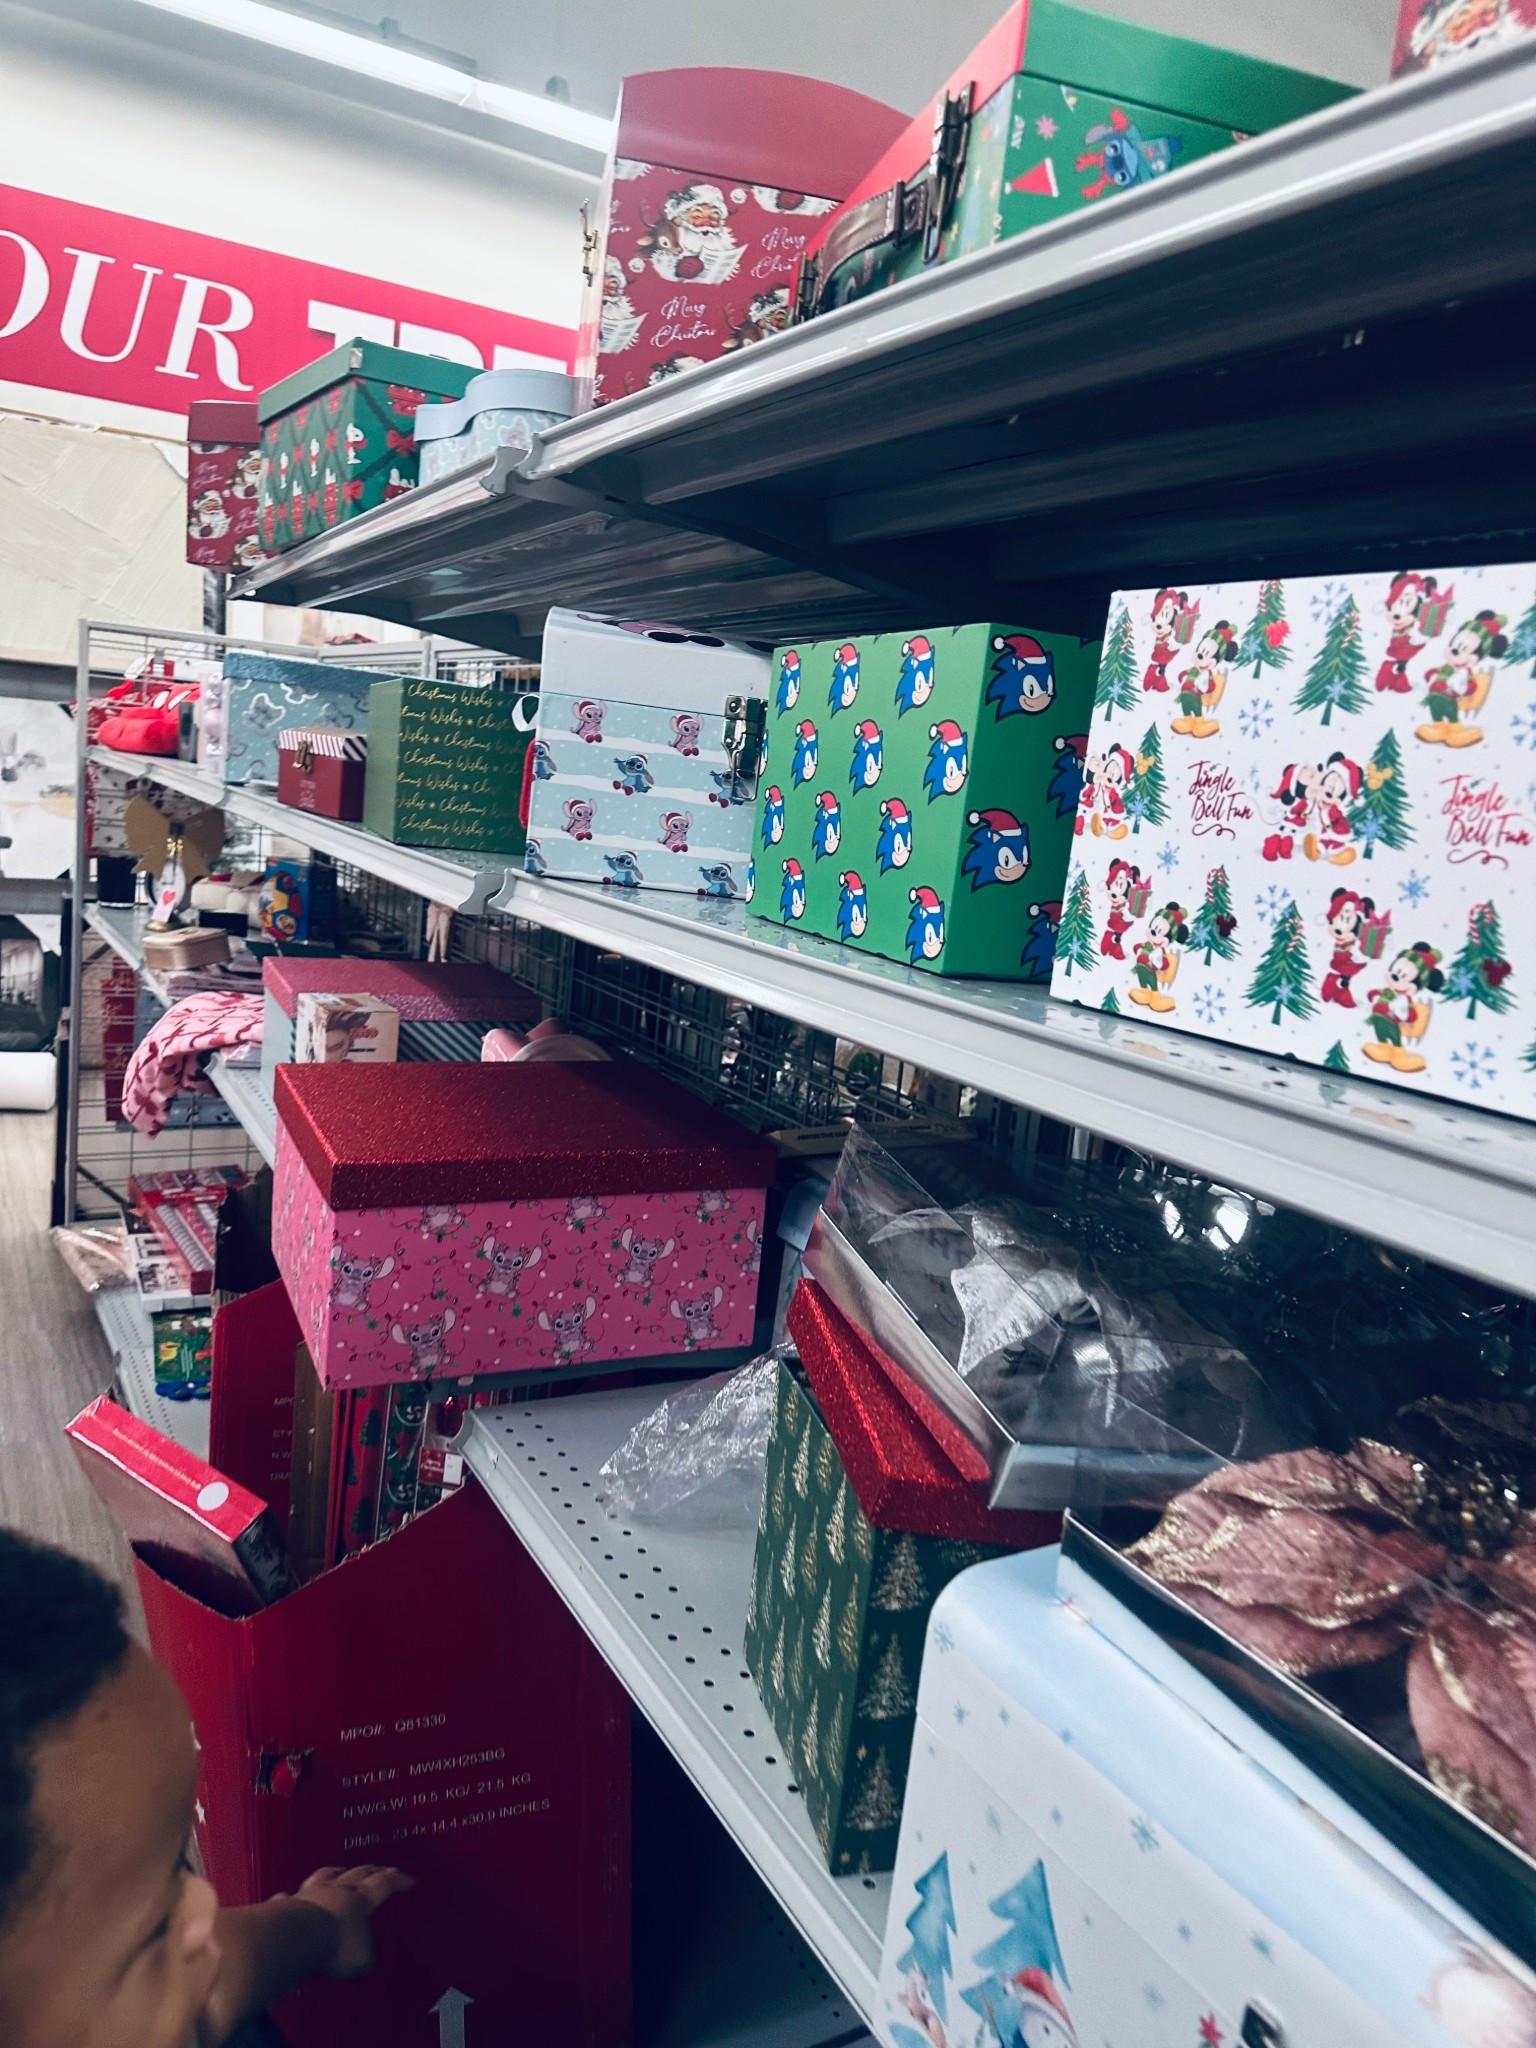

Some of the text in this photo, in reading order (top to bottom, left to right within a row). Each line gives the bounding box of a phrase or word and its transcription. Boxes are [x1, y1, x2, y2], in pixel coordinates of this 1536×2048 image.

[1187, 759, 1237, 801] Jingle
[1439, 774, 1509, 822] Jingle
[1191, 789, 1255, 821] Bell Fun
[1445, 808, 1535, 848] Bell Fun
[512, 1772, 531, 1786] KG
[499, 1798, 551, 1819] INCHES
